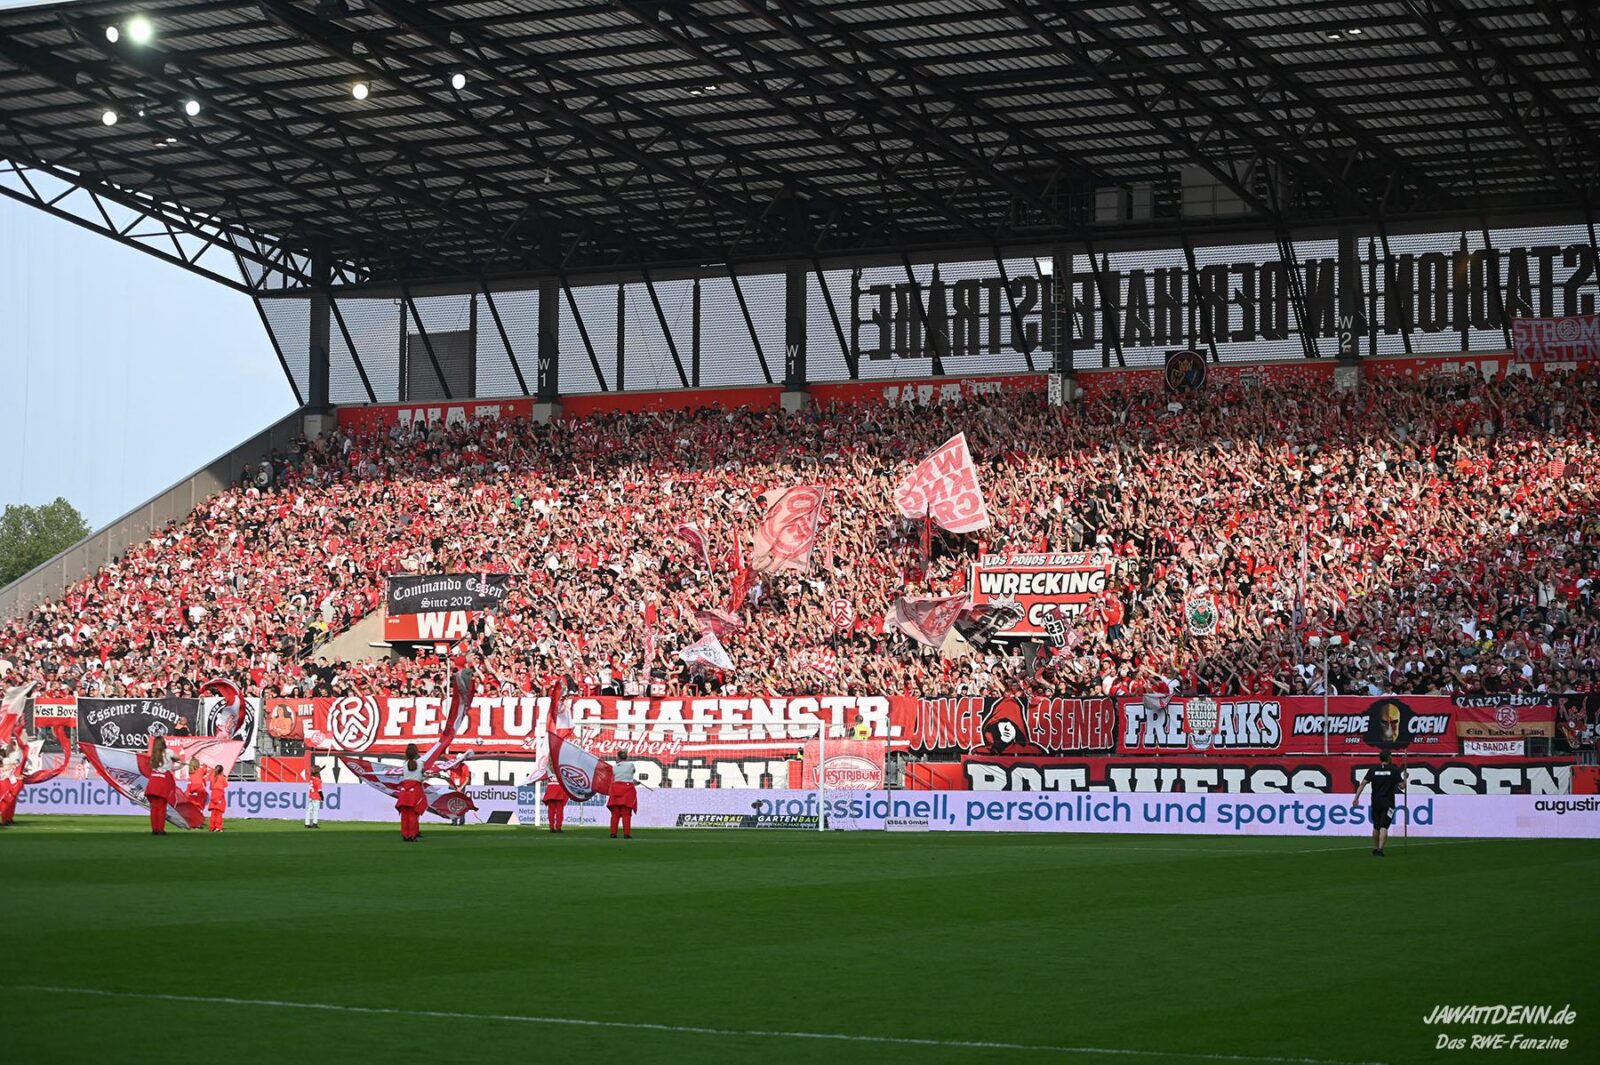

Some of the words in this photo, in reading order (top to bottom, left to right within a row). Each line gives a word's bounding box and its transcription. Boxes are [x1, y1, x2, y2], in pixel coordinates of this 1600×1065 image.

[393, 578, 461, 601] Commando
[465, 577, 503, 599] Essen
[979, 570, 1106, 595] WRECKING
[420, 597, 449, 608] Since
[450, 596, 473, 606] 2012
[86, 703, 138, 725] Essener
[1186, 702, 1218, 712] SEKTION
[1186, 711, 1218, 720] STADION
[614, 695, 902, 742] HAFENSTR
[910, 697, 985, 751] JUNGE
[1027, 696, 1116, 751] ESSENER
[1188, 719, 1217, 728] VERBOT
[1294, 714, 1370, 735] NORTHSIDE
[1407, 715, 1449, 735] CREW
[118, 733, 150, 747] 1980
[18, 782, 122, 807] ersönlich
[683, 814, 744, 823] GARTENBAU
[756, 792, 956, 826] professionell,
[966, 793, 1132, 826] persönlich
[1143, 796, 1206, 823] und
[757, 815, 820, 823] GARTENBAU
